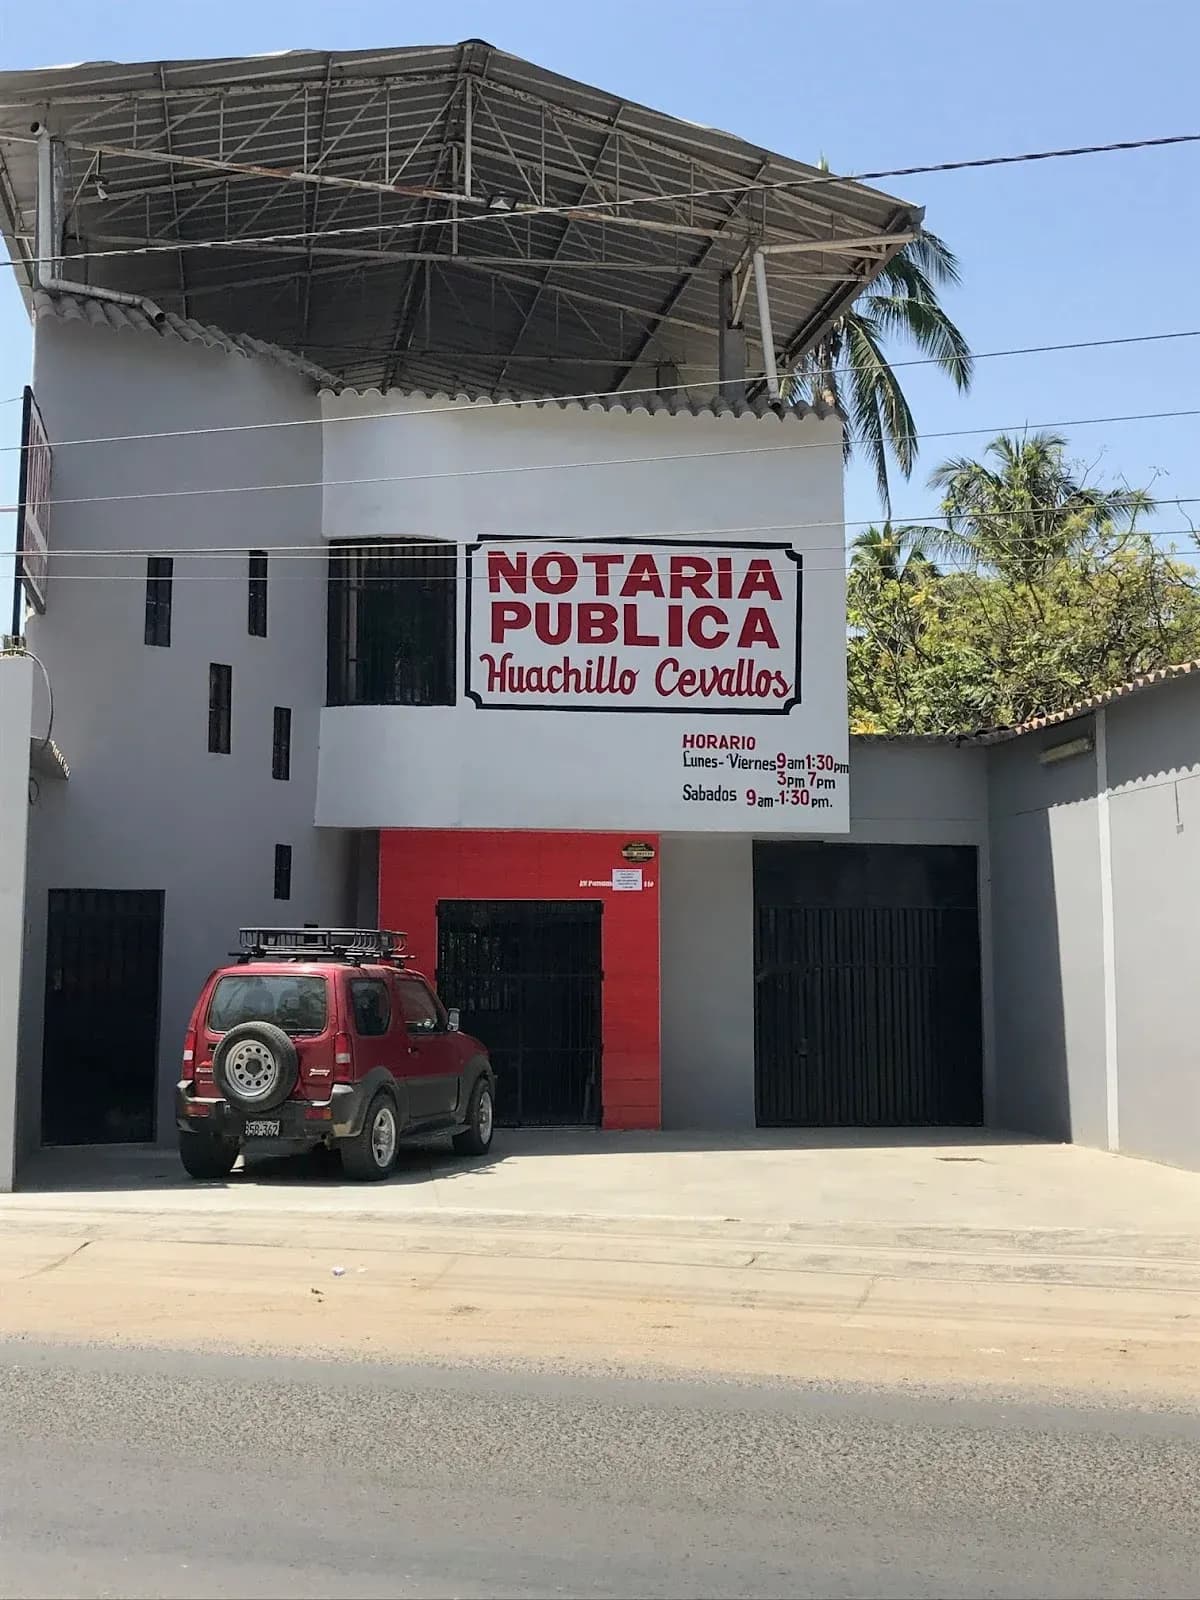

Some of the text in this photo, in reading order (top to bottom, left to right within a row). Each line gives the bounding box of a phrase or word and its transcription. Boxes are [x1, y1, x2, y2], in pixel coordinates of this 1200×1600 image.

[488, 551, 783, 600] NOTARIA
[491, 602, 780, 649] PUBLICA
[479, 652, 793, 698] Huachillo Cevallos
[682, 734, 756, 750] HORARIO
[683, 784, 737, 801] Sabados
